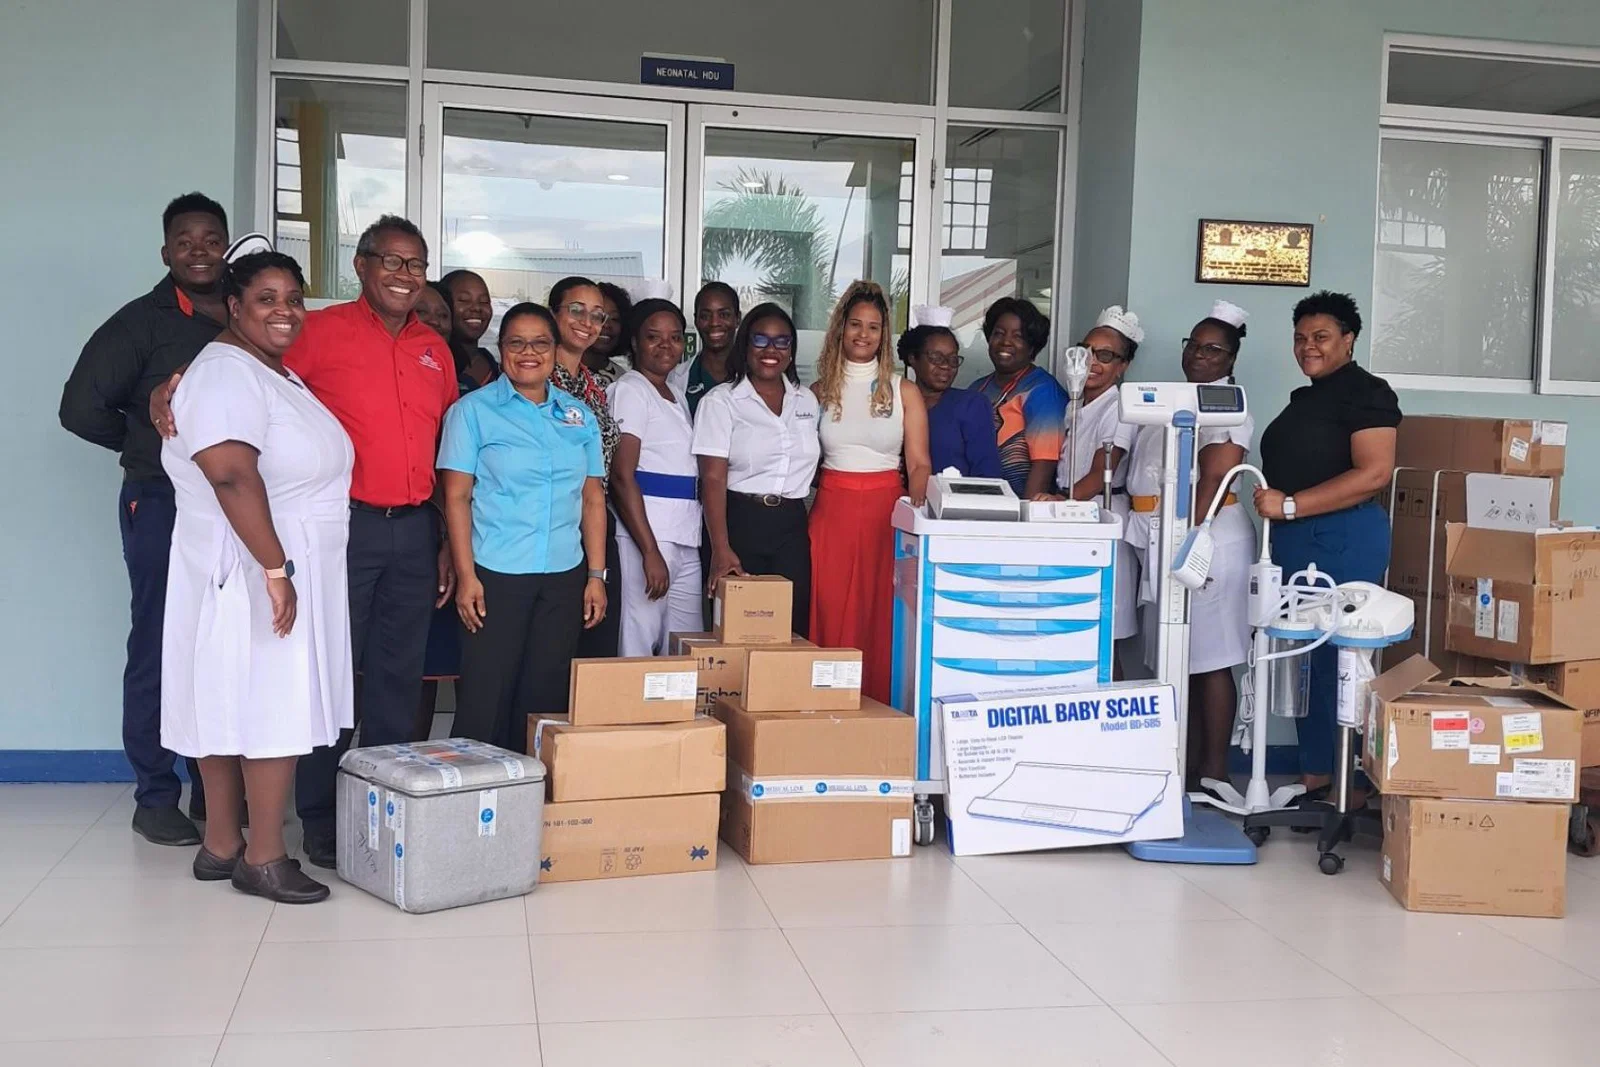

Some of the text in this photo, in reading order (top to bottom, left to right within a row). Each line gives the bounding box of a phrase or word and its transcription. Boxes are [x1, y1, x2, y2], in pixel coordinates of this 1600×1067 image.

[656, 67, 720, 81] NEONATAL HDU
[987, 695, 1160, 729] DIGITAL BABY SCALE
[1101, 718, 1161, 732] Model BD-585
